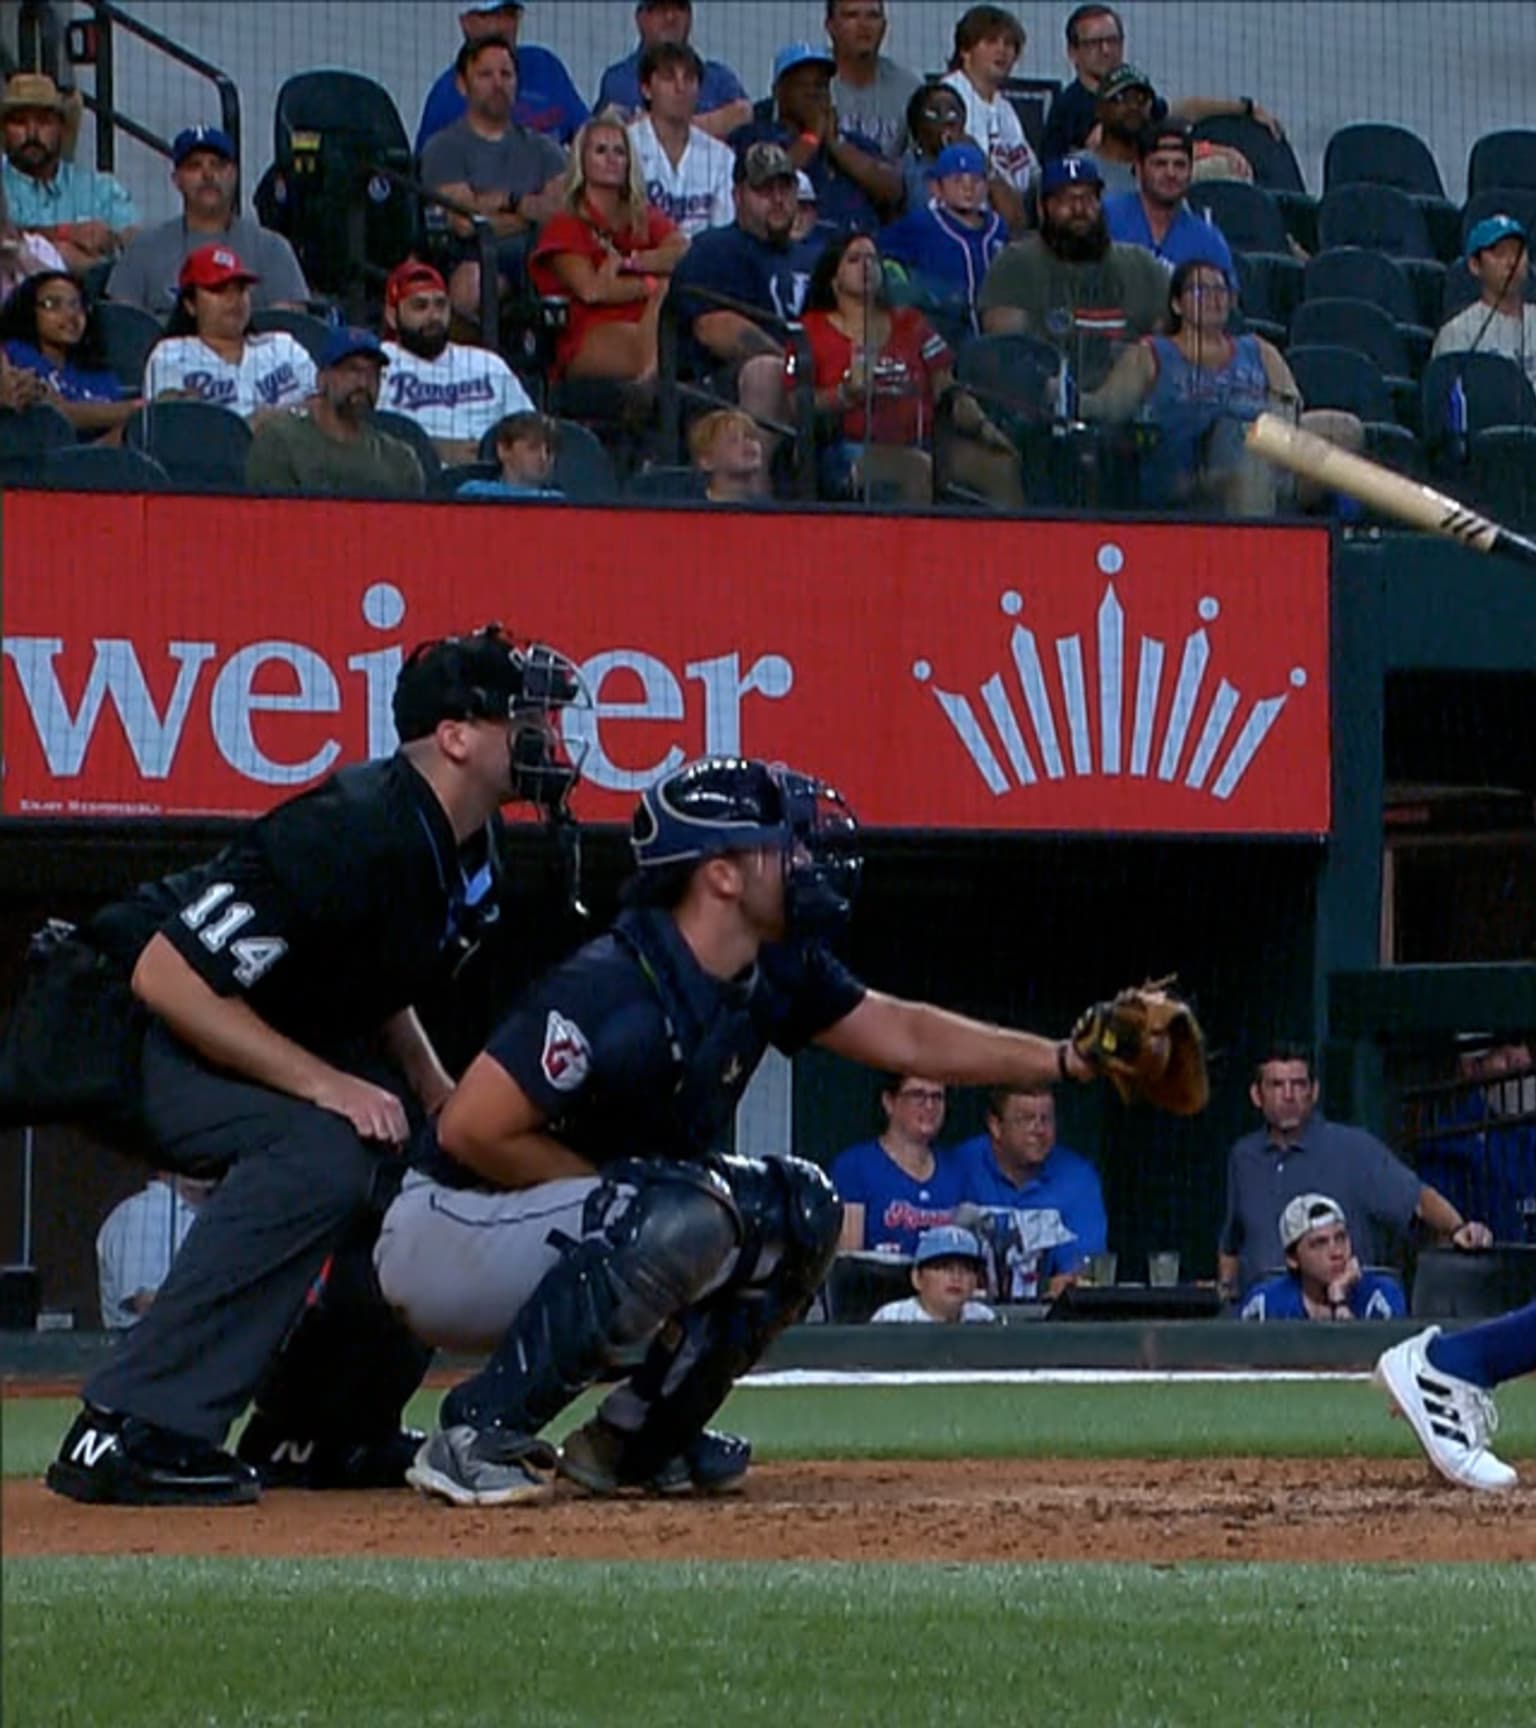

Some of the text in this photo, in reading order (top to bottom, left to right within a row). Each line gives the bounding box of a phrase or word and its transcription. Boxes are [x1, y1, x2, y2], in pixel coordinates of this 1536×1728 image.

[1063, 158, 1081, 179] T
[388, 372, 495, 412] Rangers
[0, 580, 795, 790] weier
[179, 883, 289, 988] 114
